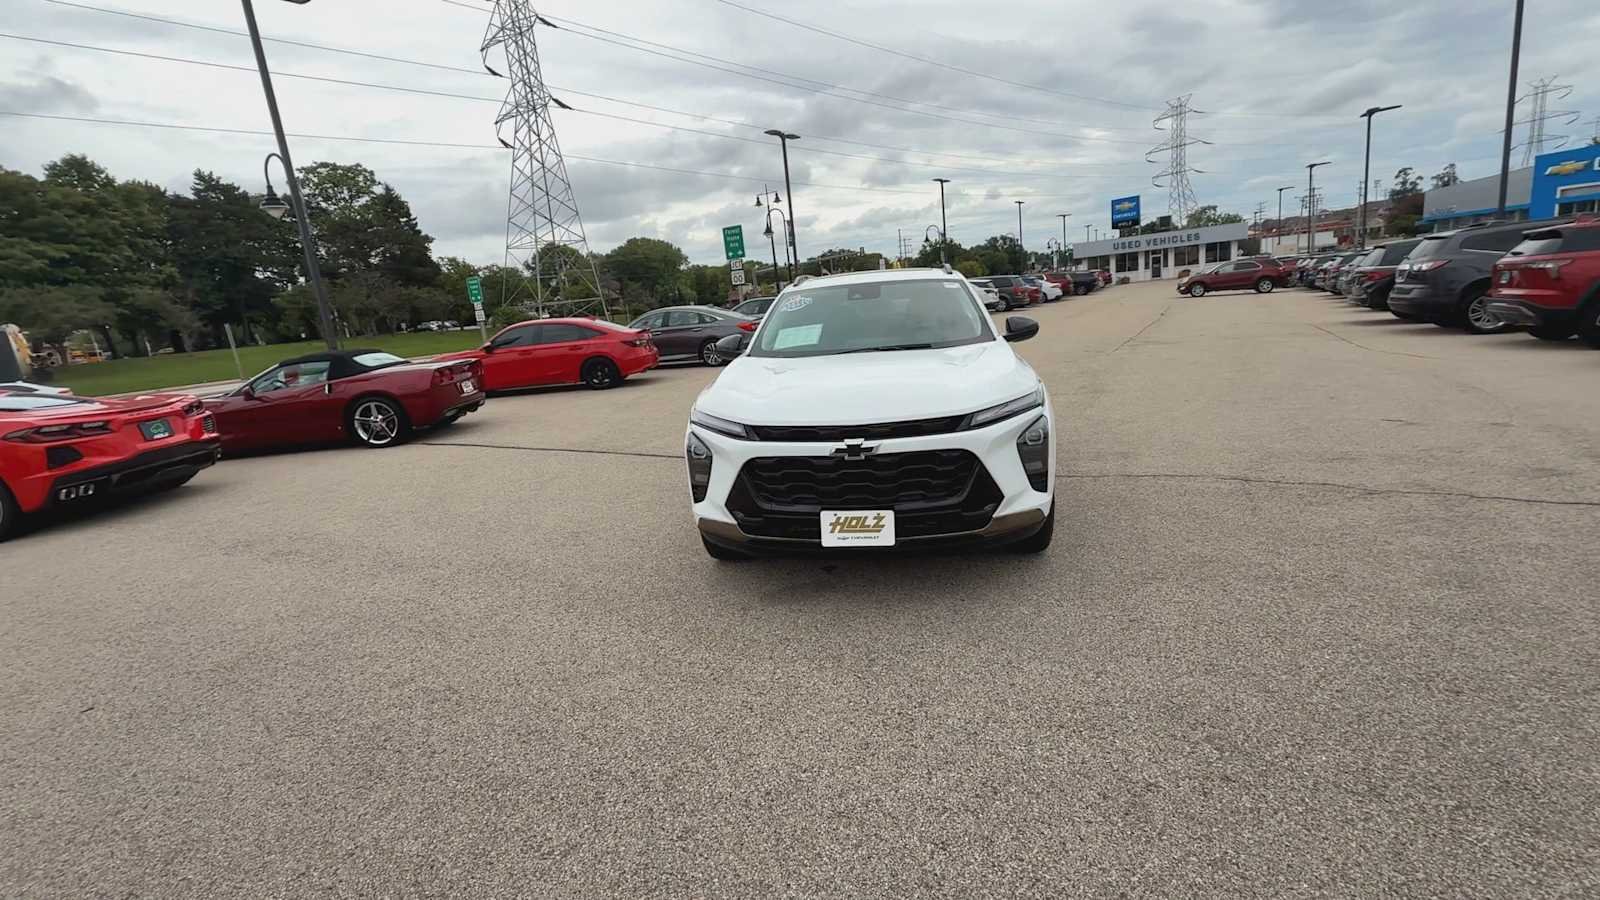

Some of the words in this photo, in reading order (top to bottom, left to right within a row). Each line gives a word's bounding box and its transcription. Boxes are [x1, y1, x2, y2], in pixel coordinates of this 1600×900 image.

[1113, 240, 1141, 250] USED
[1146, 232, 1200, 247] VEHICLES
[829, 512, 886, 533] HOLZ
